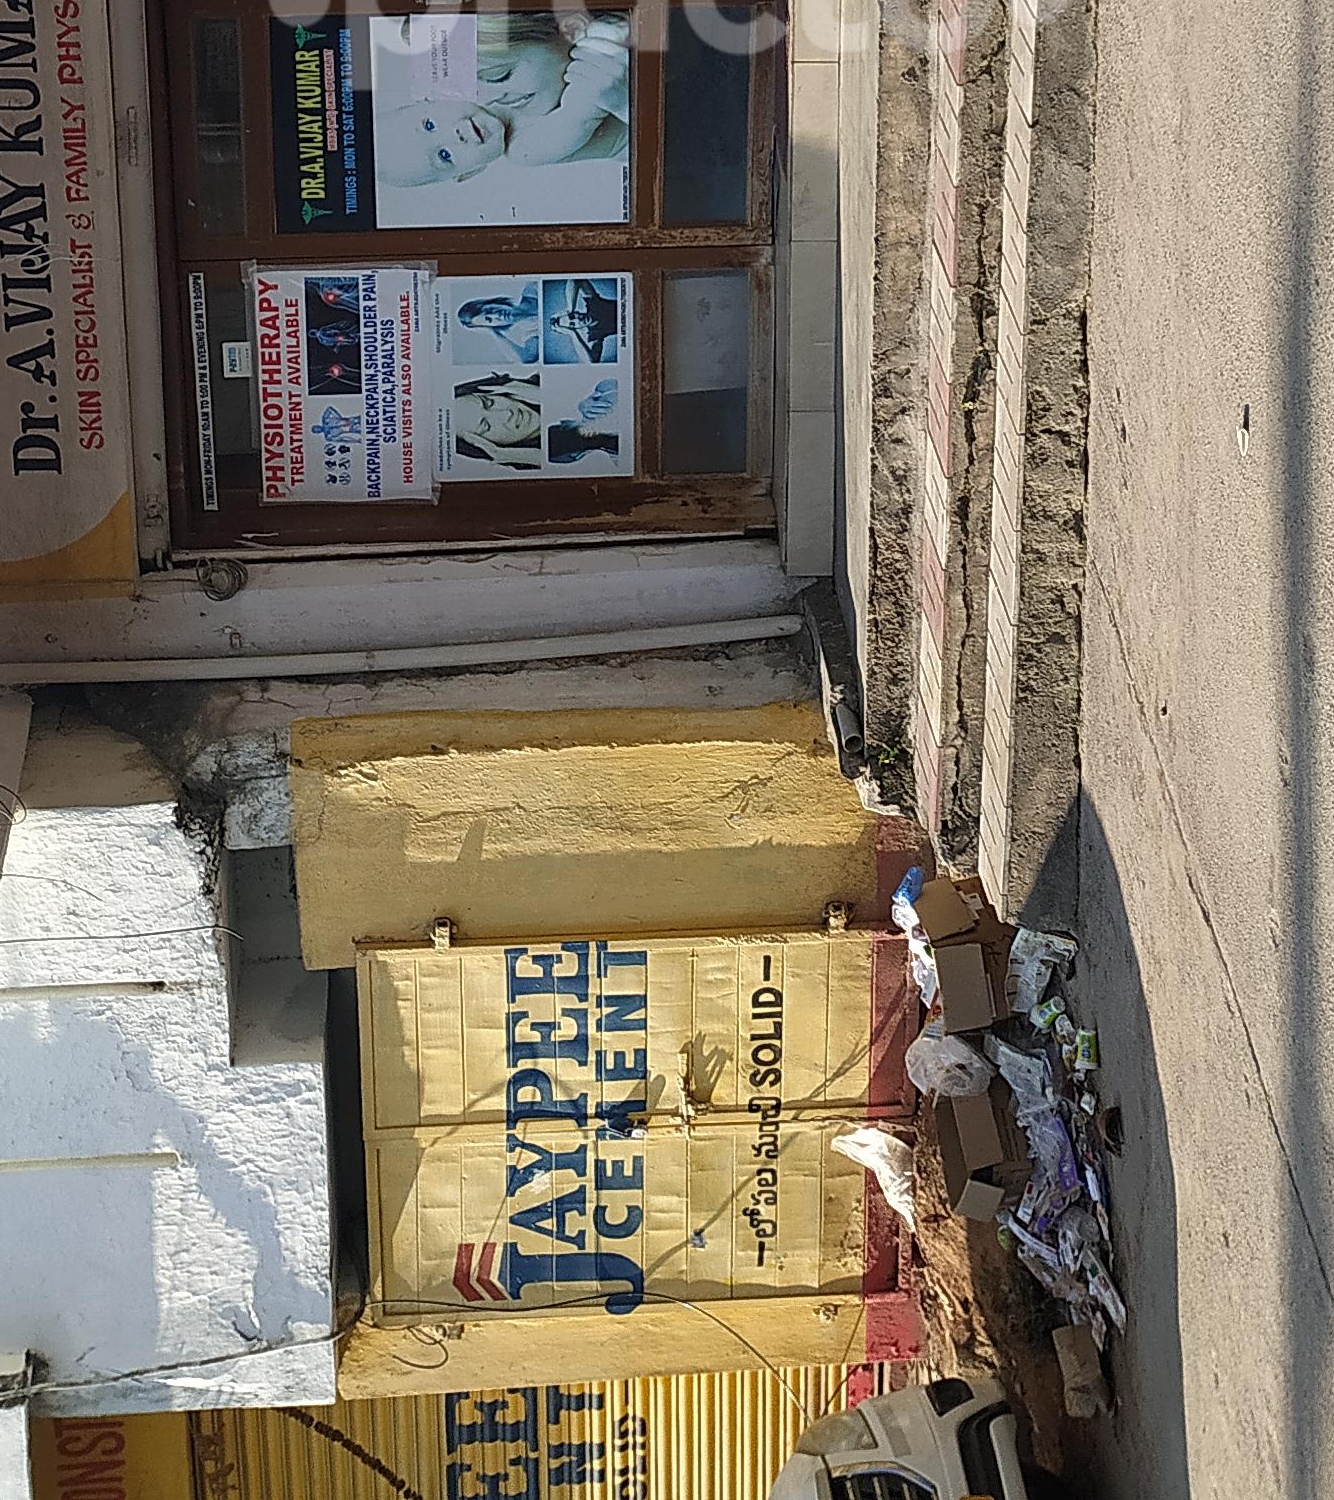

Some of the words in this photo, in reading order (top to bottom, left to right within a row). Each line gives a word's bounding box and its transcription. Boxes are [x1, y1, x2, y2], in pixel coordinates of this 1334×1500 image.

[294, 49, 322, 109] KUMAR
[340, 64, 352, 76] TO
[342, 113, 355, 131] SAT
[343, 133, 355, 146] TO
[60, 96, 89, 202] FAMILY
[297, 113, 326, 199] DR.A.VIJAY
[343, 147, 356, 169] MON
[345, 175, 358, 214] TIMINGS
[193, 301, 204, 312] TO
[361, 270, 379, 302] PAIN,
[69, 238, 101, 382] SPECIALIST
[399, 290, 411, 361] AVAILABLE.
[195, 331, 207, 363] EVENING
[284, 298, 302, 386] AVAILABLE
[197, 372, 208, 383] PM
[257, 277, 286, 498] PHYSIOTHERAPY
[379, 318, 398, 443] SCIATICA,PARALYSIS
[400, 364, 411, 396] ALSO
[77, 391, 105, 450] SKIN
[199, 399, 210, 410] TO
[400, 399, 412, 439] VISITS
[201, 433, 214, 476] MON-FRIDAY
[287, 390, 305, 486] TREATMENT
[401, 441, 413, 484] HOUSE
[204, 476, 216, 506] TIMINGS
[748, 986, 783, 1088] SOLID
[595, 941, 648, 1239] CEMENT
[499, 941, 644, 1315] JAYPEE
